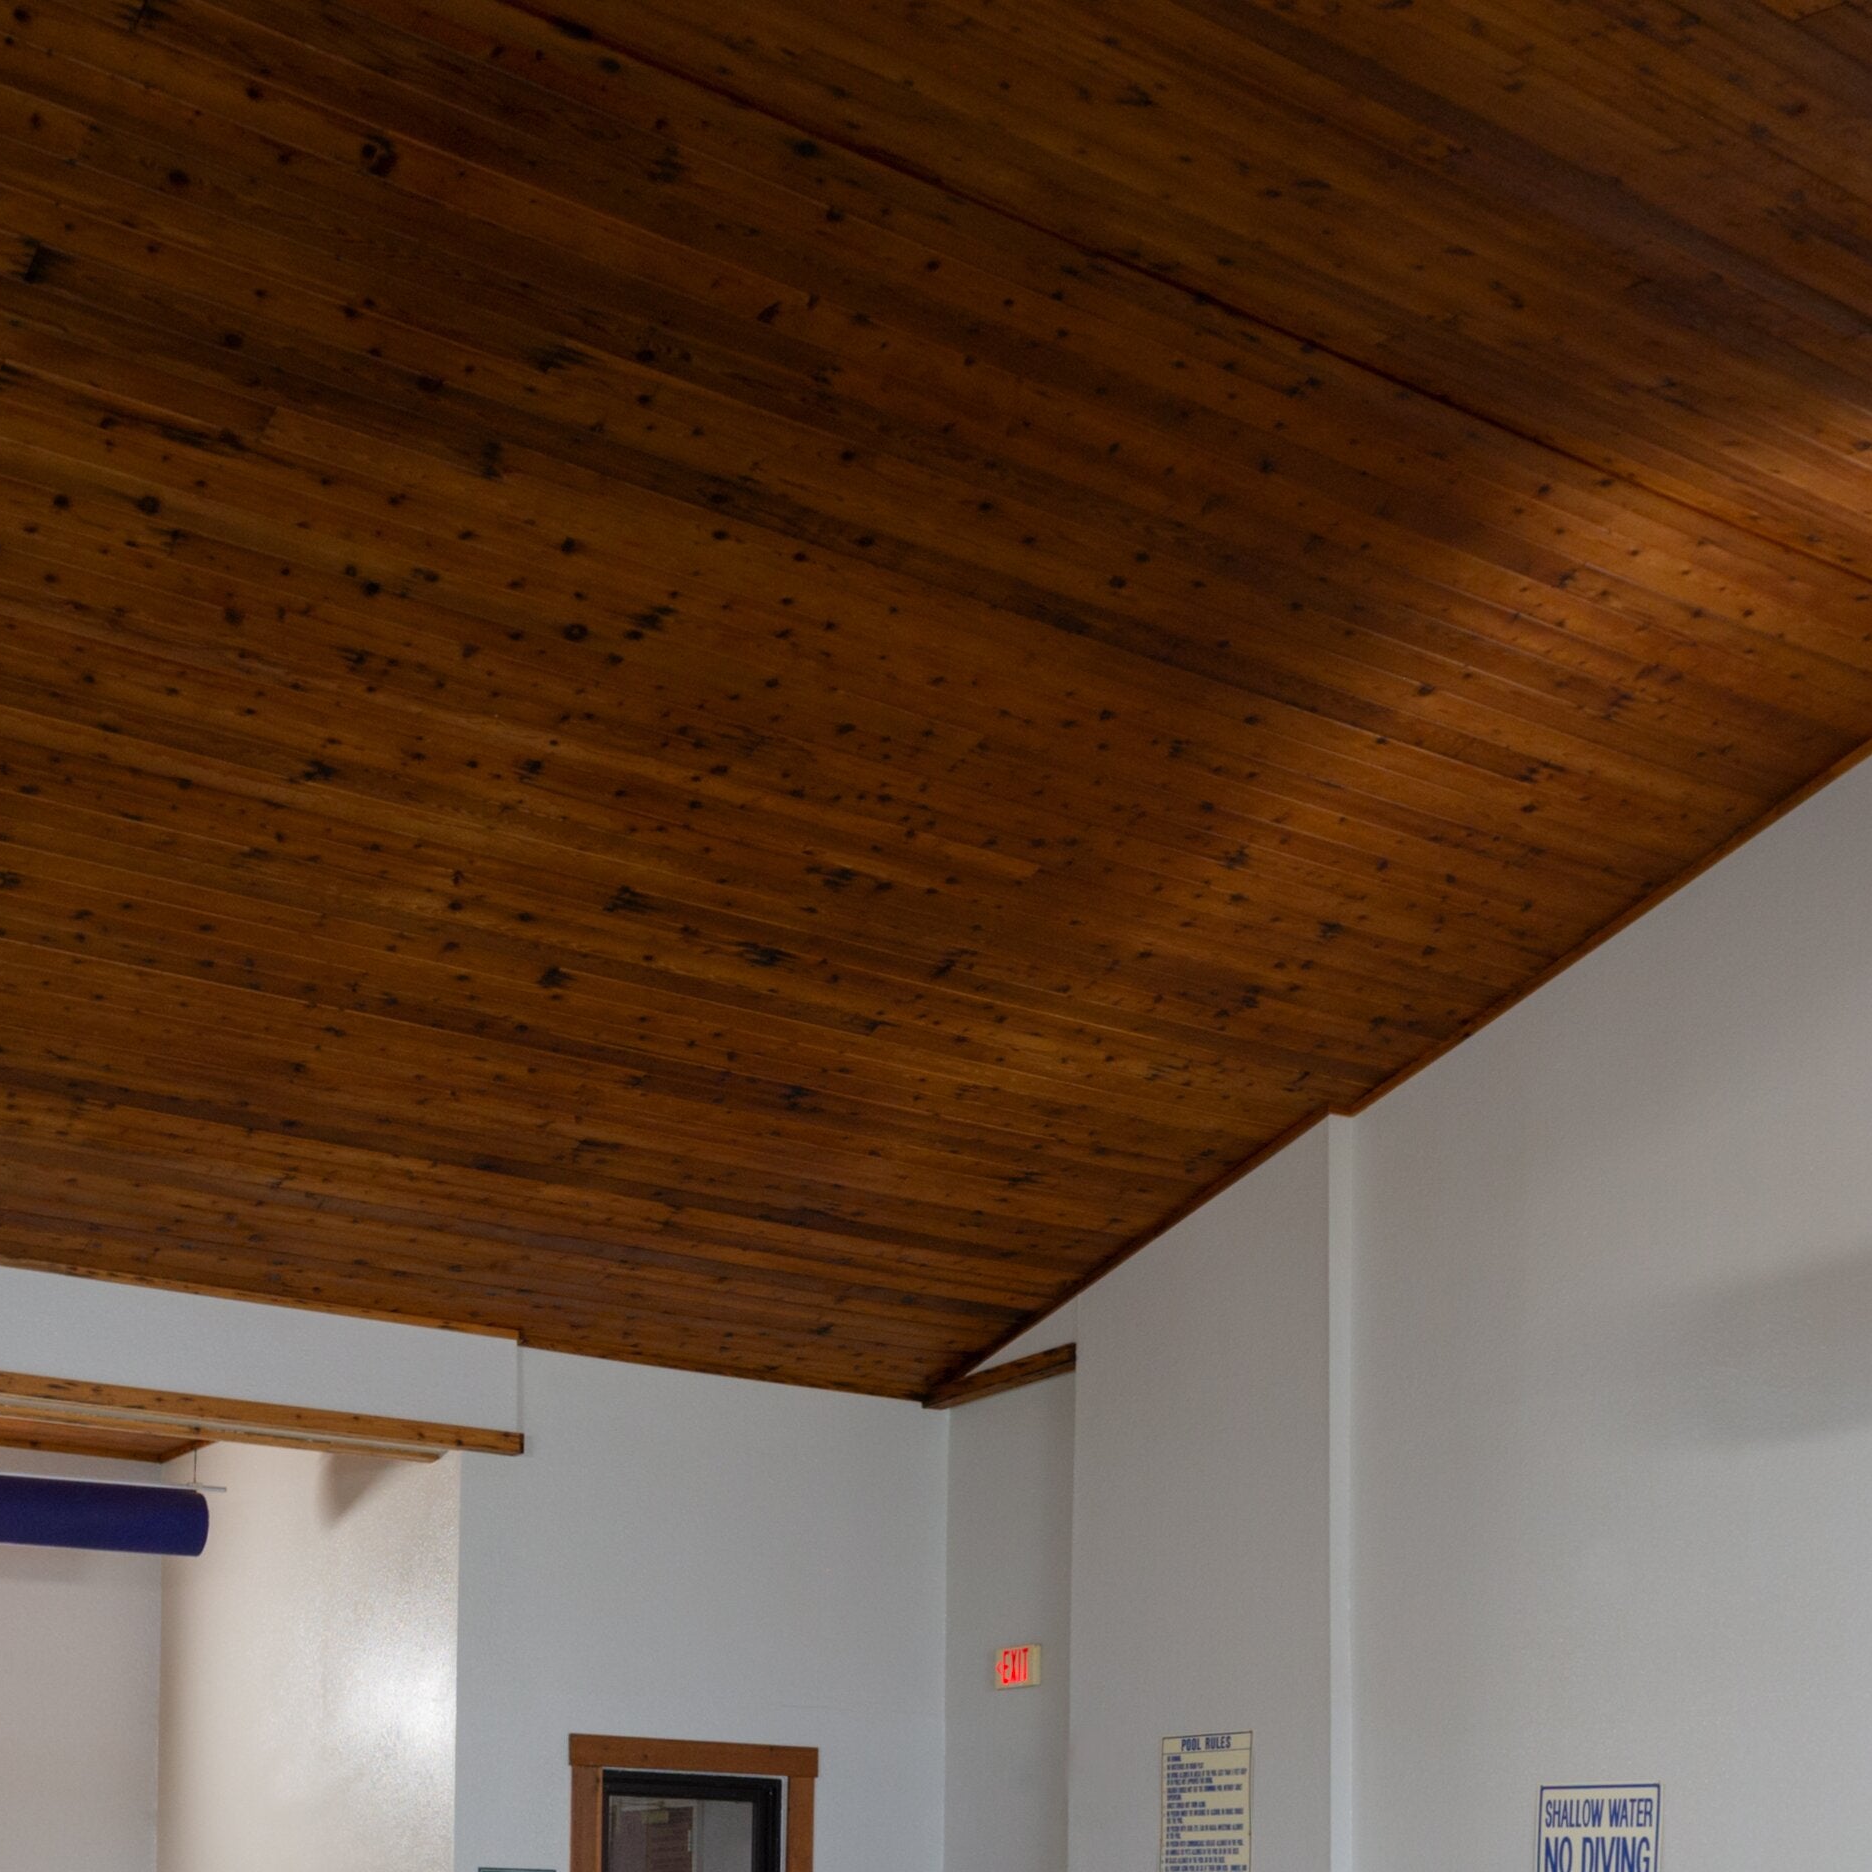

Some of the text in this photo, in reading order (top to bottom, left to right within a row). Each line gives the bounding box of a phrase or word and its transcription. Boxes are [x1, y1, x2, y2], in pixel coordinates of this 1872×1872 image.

[1181, 1735, 1231, 1751] POOL RULES
[1545, 1797, 1653, 1828] SHALLOW WATER
